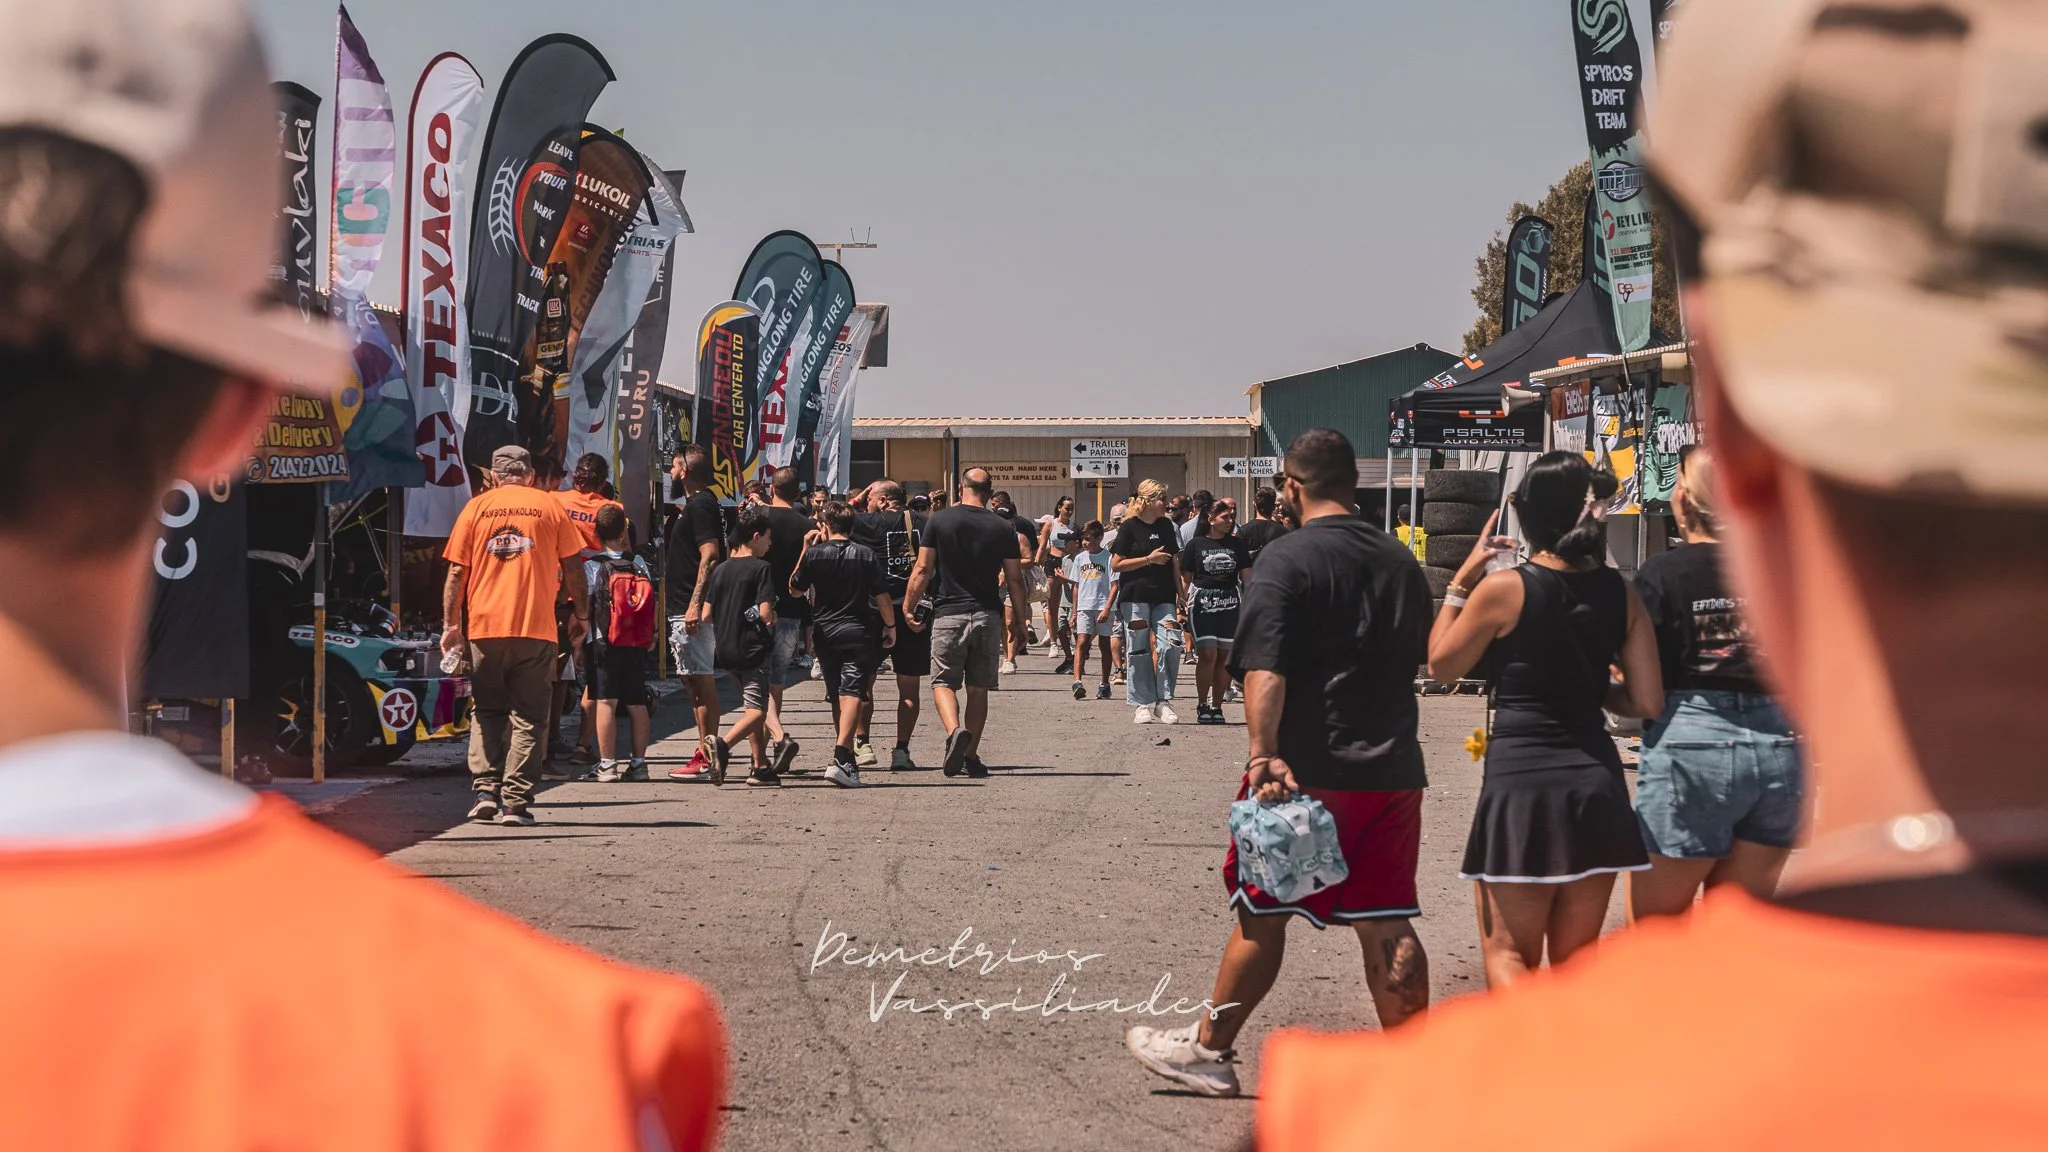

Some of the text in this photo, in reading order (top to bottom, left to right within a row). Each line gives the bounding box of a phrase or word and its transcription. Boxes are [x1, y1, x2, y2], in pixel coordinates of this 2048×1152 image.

[1584, 64, 1633, 82] SPYROS
[1591, 88, 1625, 106] DRIFT
[1595, 112, 1627, 129] TEAM
[547, 140, 574, 161] LEAVE
[538, 170, 567, 191] YOUR
[582, 176, 631, 210] LUKOIL
[533, 200, 556, 221] MARK
[574, 193, 624, 222] BRICANTS
[422, 112, 457, 388] TEXACO
[787, 266, 813, 308] TIRE
[517, 292, 540, 314] TRACK
[822, 293, 845, 332] TIRE
[711, 327, 733, 460] ANDREOU
[732, 333, 744, 449] CAR CENTER LTD
[628, 369, 650, 440] GURU
[1442, 428, 1525, 437] PSALTIS
[1090, 440, 1126, 448] TRAILER
[1090, 448, 1127, 456] PARKING
[269, 453, 347, 478] 24422024
[481, 508, 543, 519] PAMBOS NIKOLAOU
[1212, 595, 1238, 608] Angeles
[291, 631, 356, 645] TEACO
